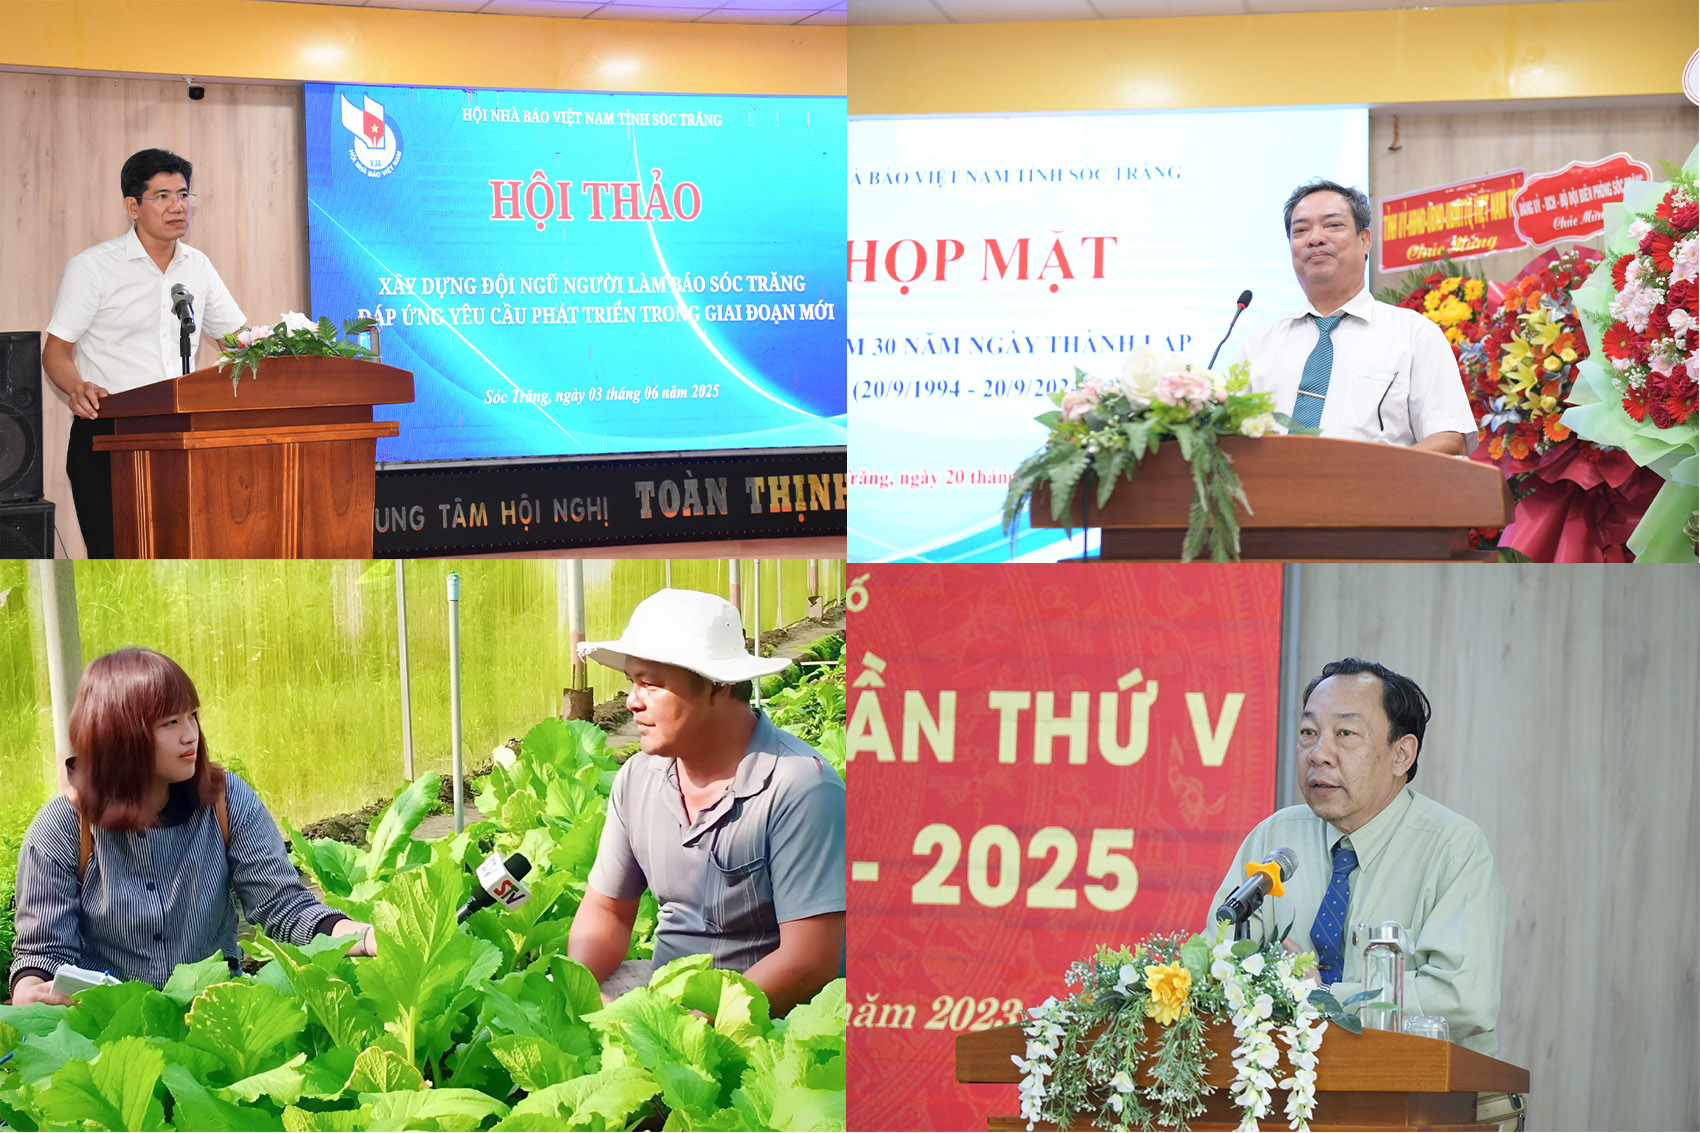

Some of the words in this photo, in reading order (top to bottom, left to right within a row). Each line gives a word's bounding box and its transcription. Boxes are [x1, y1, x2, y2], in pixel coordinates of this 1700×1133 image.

[462, 106, 488, 124] HỘI
[491, 107, 520, 123] NHÀ
[523, 106, 550, 123] BÁO
[553, 109, 582, 127] VIỆT
[585, 112, 615, 125] NAM
[617, 109, 650, 126] TỈNH
[652, 110, 677, 126] SÓC
[679, 111, 723, 127] TRĂNG
[869, 166, 909, 185] BÁO
[915, 168, 960, 188] VIỆT
[966, 169, 1010, 184] NAM
[1068, 163, 1107, 182] SÓC
[1114, 162, 1182, 181] TRĂNG
[489, 169, 573, 231] HỘI
[582, 168, 702, 222] THẢO
[847, 238, 965, 296] HỌP
[980, 228, 1118, 294] MẶT
[379, 273, 416, 295] XÂY
[421, 277, 477, 299] DỰNG
[481, 272, 515, 299] ĐỘI
[520, 273, 558, 295] NGŨ
[563, 272, 624, 295] NGƯỜI
[628, 272, 667, 293] LÀM
[671, 272, 706, 293] BÁO
[710, 272, 743, 292] SÓC
[746, 271, 806, 292] TRĂNG
[357, 304, 397, 326] ĐÁP
[401, 303, 445, 326] ỨNG
[450, 303, 486, 325] YÊU
[490, 302, 527, 325] CẦU
[531, 302, 579, 324] PHÁT
[582, 300, 636, 323] TRIỂN
[640, 305, 701, 322] TRONG
[704, 304, 742, 322] GIAI
[746, 303, 795, 325] ĐOẠN
[799, 299, 835, 321] MỚI
[872, 337, 896, 356] 30
[904, 332, 960, 355] NĂM
[969, 330, 1039, 355] NGÀY
[1046, 329, 1134, 353] THÀNH
[484, 389, 507, 405] Sóc
[511, 389, 551, 406] Trăng,
[556, 387, 585, 406] ngày
[588, 386, 602, 401] 03
[606, 385, 641, 404] tháng
[644, 385, 659, 400] 06
[662, 385, 688, 399] năm
[691, 384, 720, 398] 2025
[852, 379, 960, 403] (20/9/1994
[900, 469, 939, 489] ngày
[945, 468, 965, 485] 20
[634, 470, 729, 519] TOÀN
[745, 473, 847, 523] THỊNH
[438, 497, 488, 529] TÂM
[501, 493, 541, 531] HỘI
[553, 496, 609, 527] NGHỊ
[846, 651, 957, 762] ẦN
[988, 667, 1158, 767] THỨ
[1185, 692, 1246, 767] V
[852, 862, 879, 881] -
[911, 823, 1139, 912] 2025
[493, 880, 526, 905] STV
[923, 995, 1024, 1031] 2023
